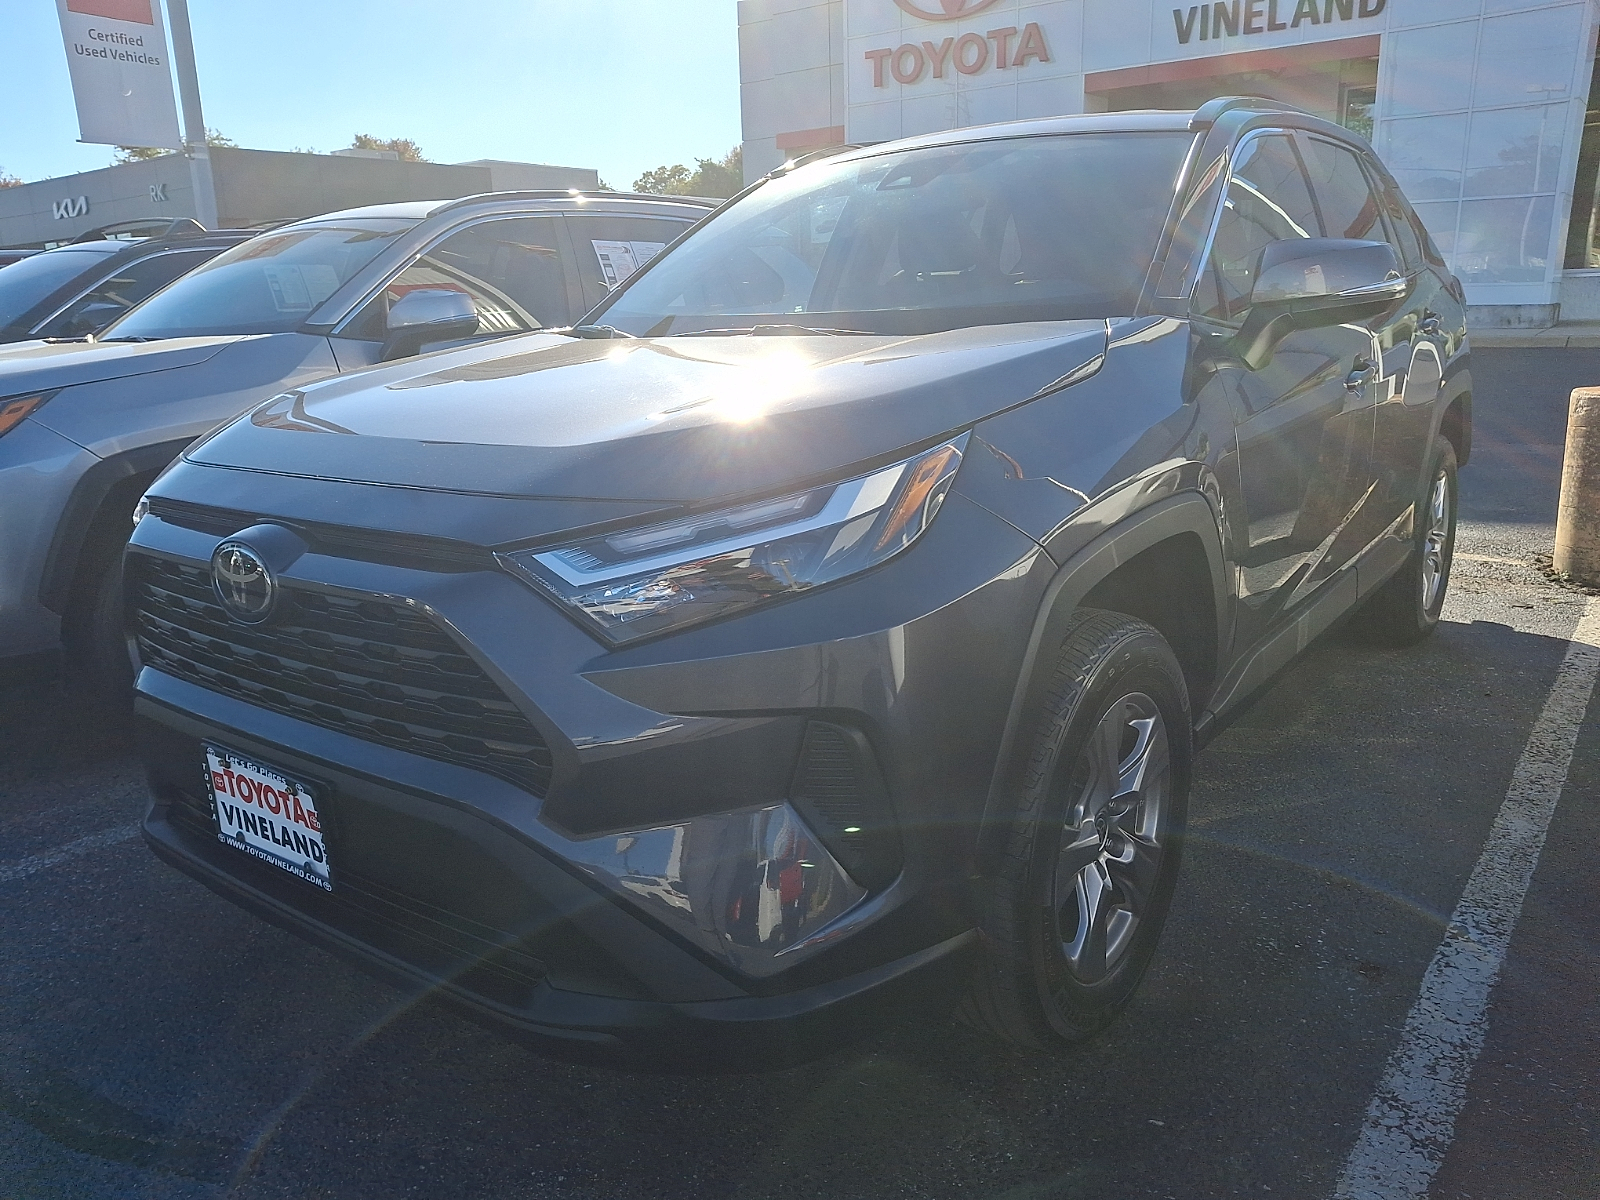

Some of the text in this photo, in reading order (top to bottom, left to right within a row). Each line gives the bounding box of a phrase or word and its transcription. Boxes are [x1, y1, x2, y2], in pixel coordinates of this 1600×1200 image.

[88, 28, 143, 47] Certified
[1172, 0, 1386, 45] VINELAND
[74, 43, 160, 66] Used Vehicles
[865, 22, 1050, 88] TOYOTA
[149, 183, 166, 202] RK
[247, 762, 258, 773] Go
[260, 768, 286, 784] Places
[223, 768, 311, 829] TOYOTA
[221, 801, 324, 863] VINELAND
[226, 837, 322, 887] WWW.TOYOTAVINELAND.COM
